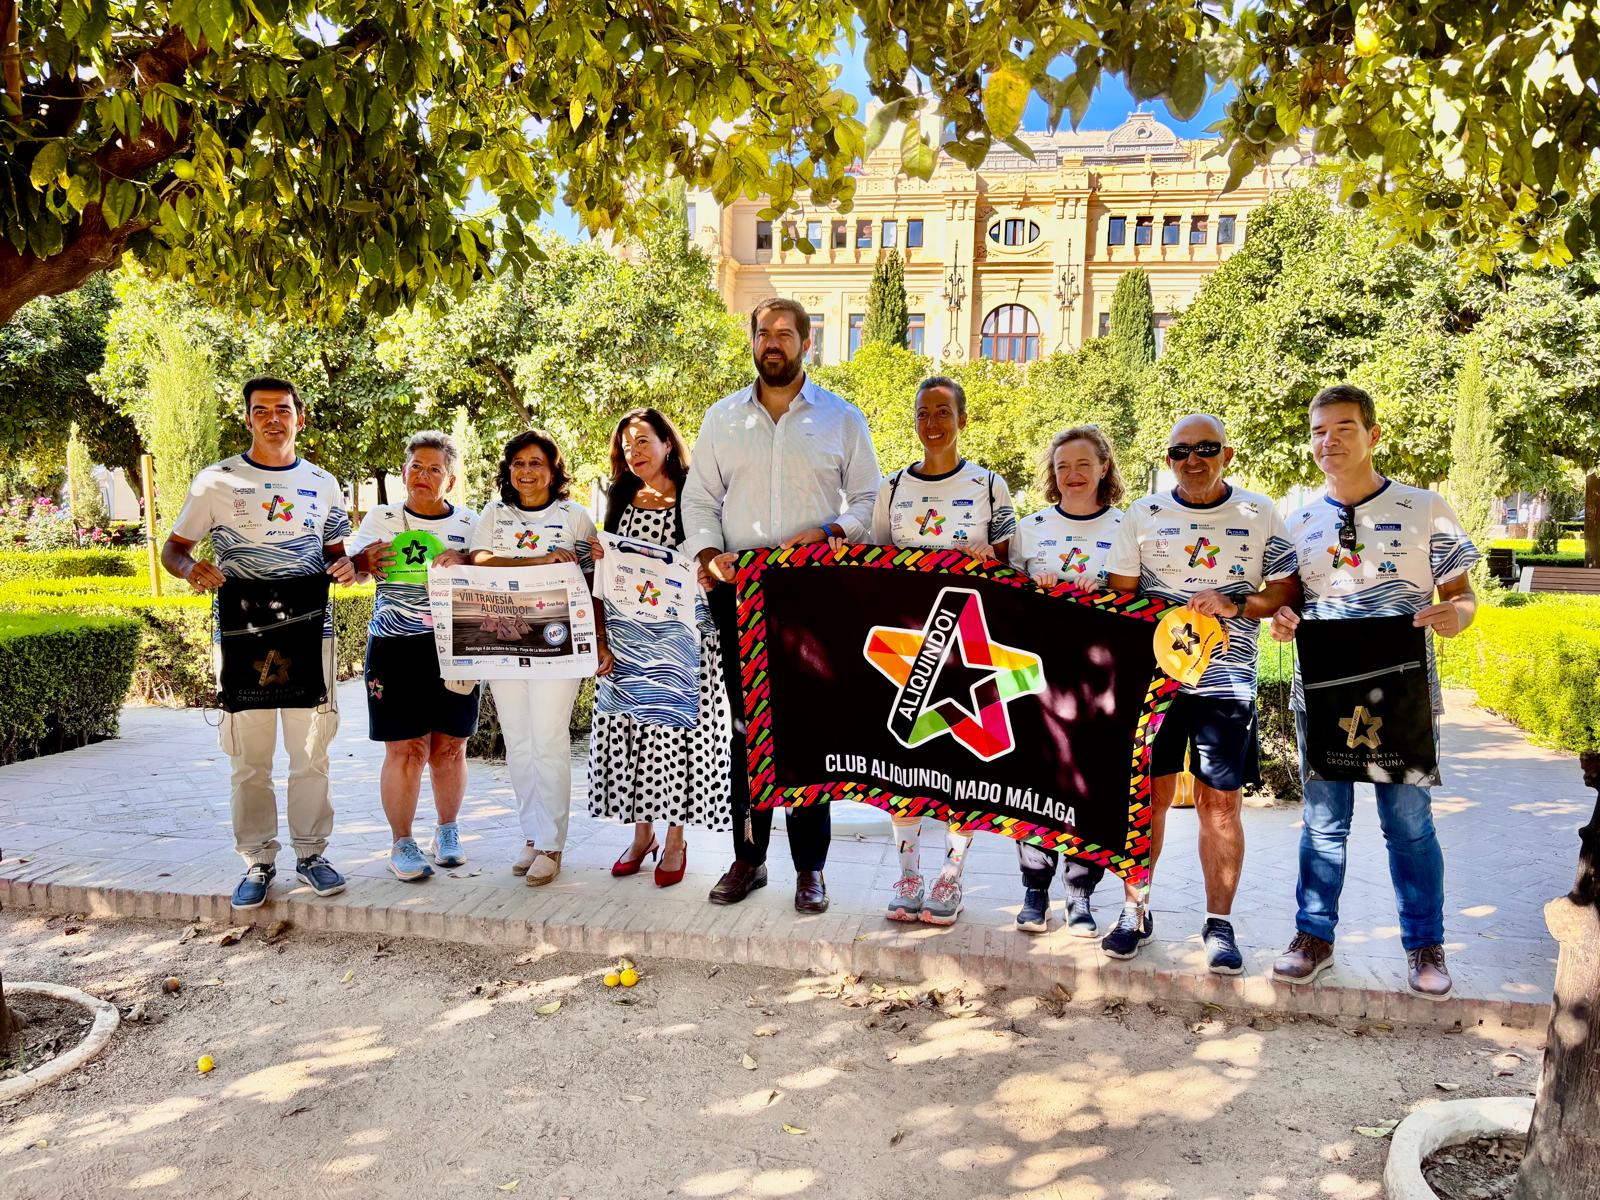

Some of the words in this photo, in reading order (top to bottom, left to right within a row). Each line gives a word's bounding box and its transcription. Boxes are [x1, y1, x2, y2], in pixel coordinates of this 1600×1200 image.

[459, 592, 473, 601] VIII
[475, 593, 514, 605] TRAVESÍA
[898, 608, 957, 721] ALIQUINDOI
[825, 754, 867, 774] CLUB
[954, 780, 1002, 804] NADO
[1005, 787, 1076, 827] MÁLAGA
